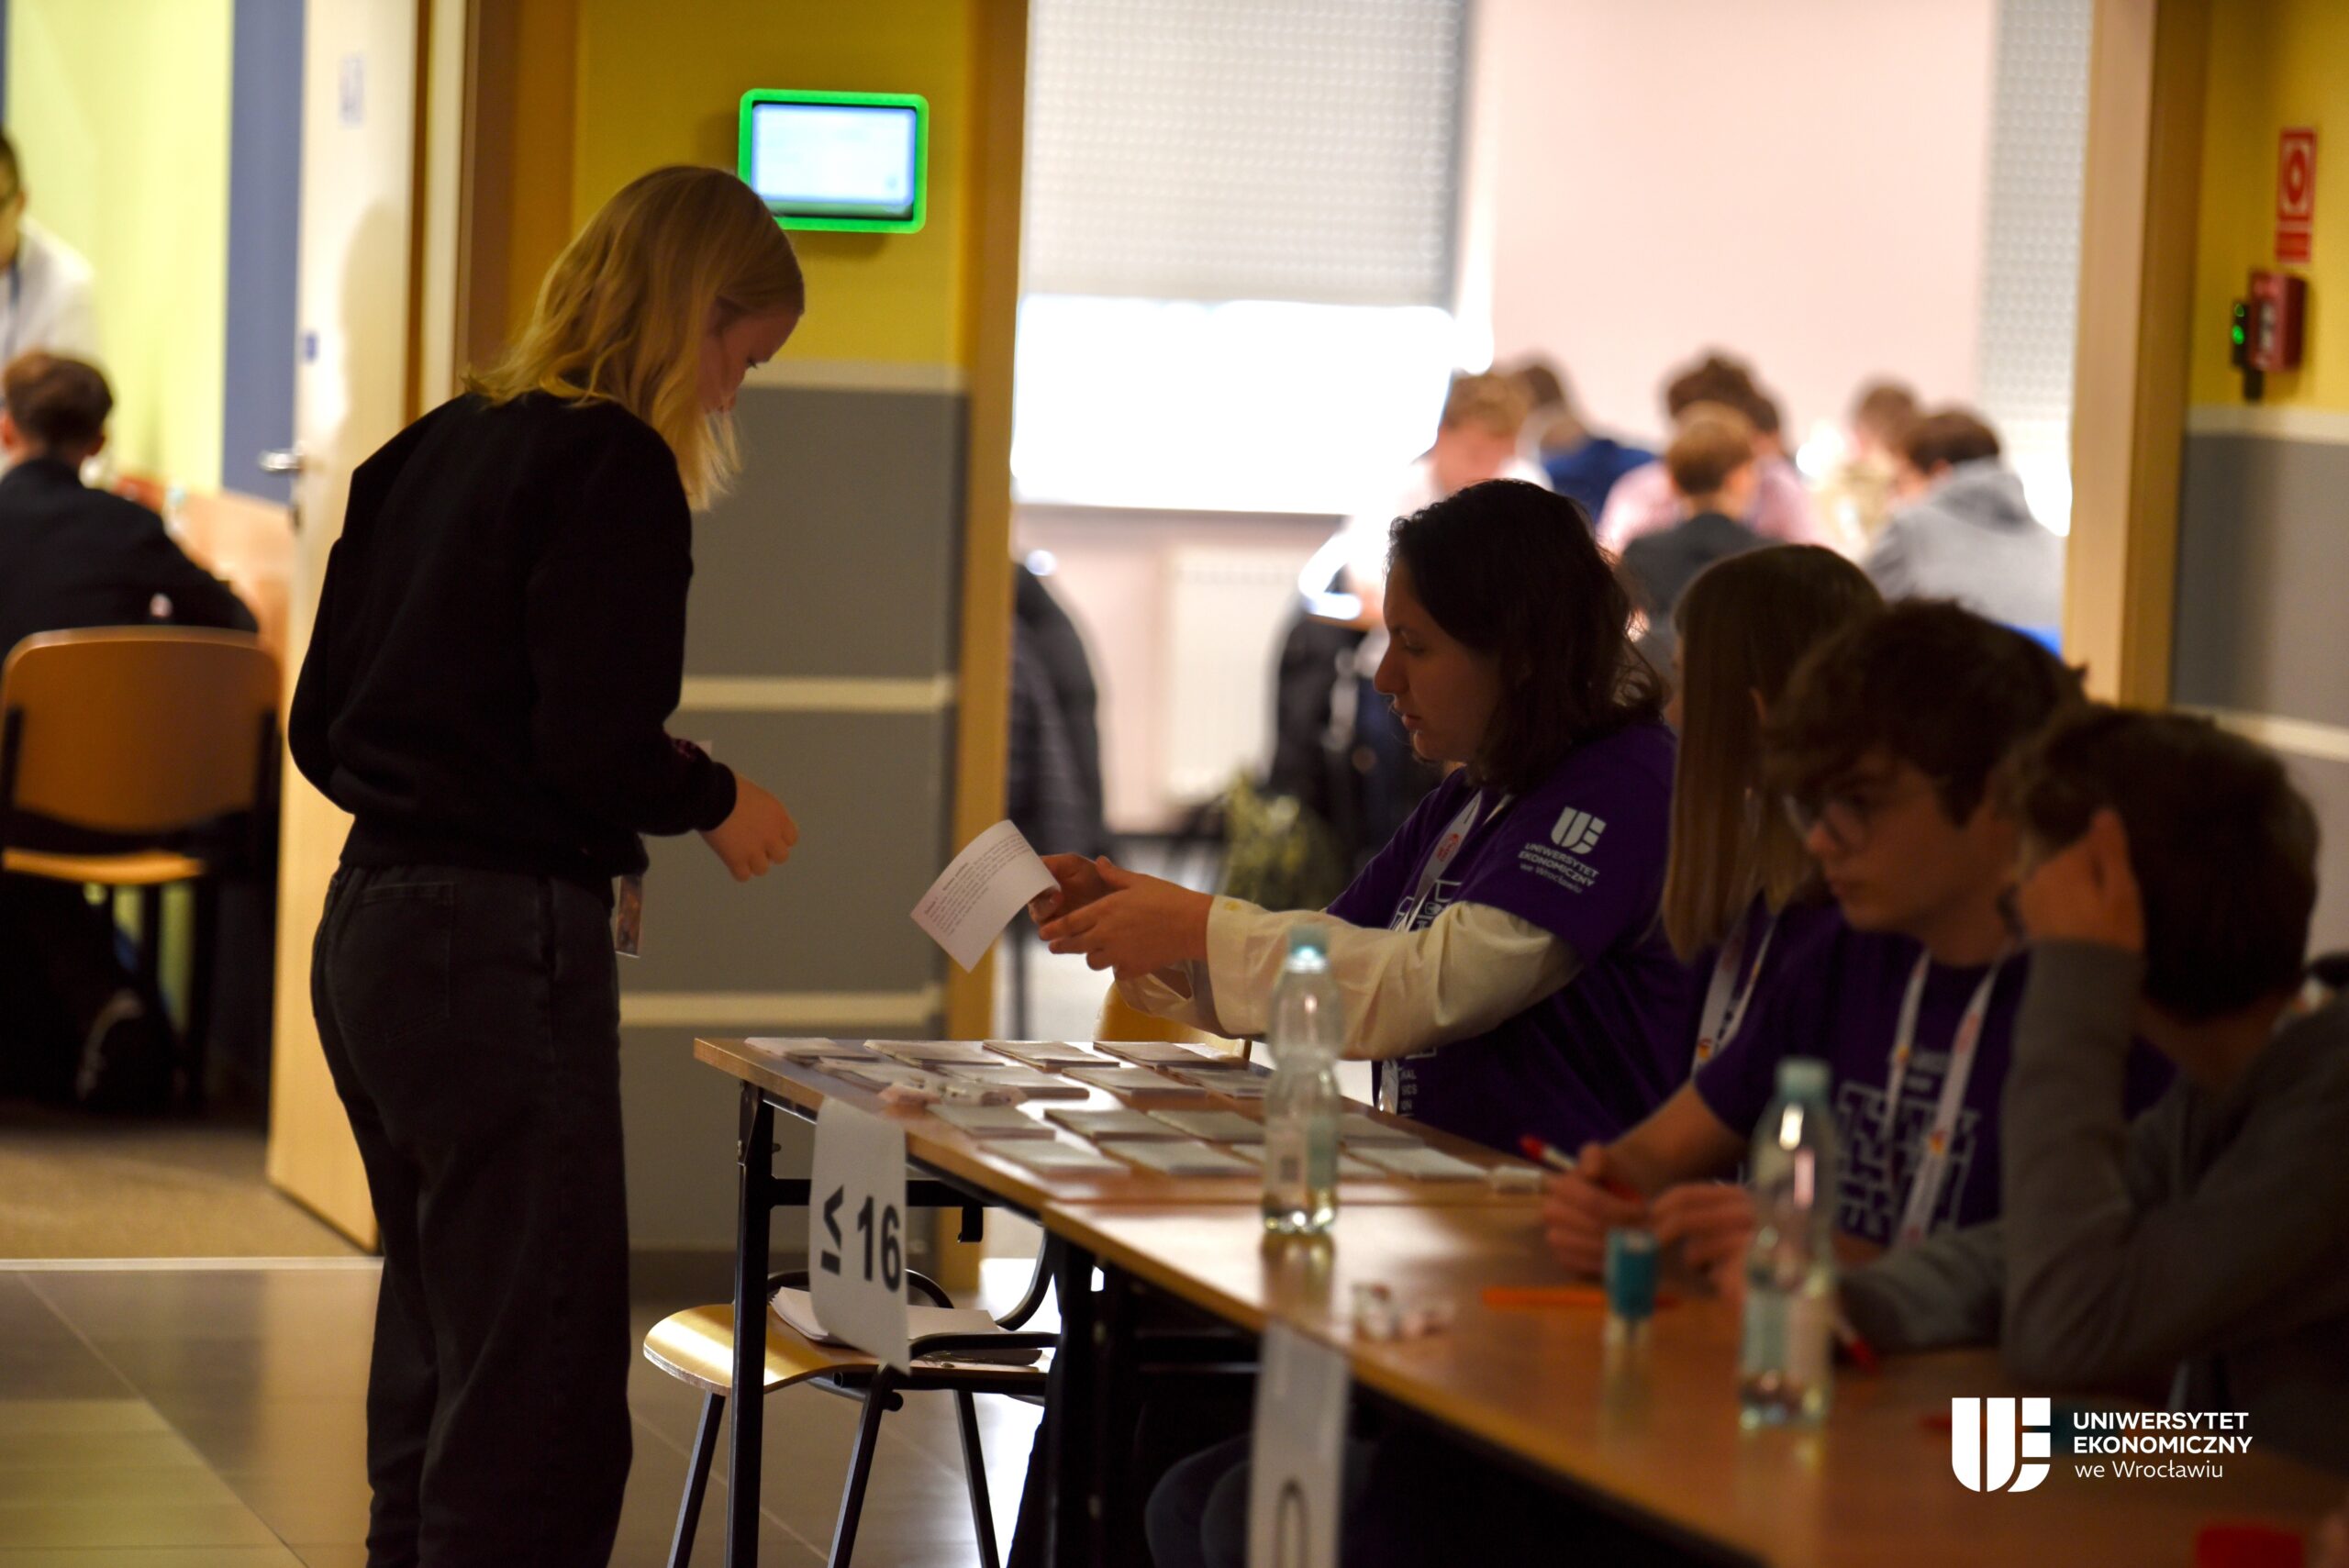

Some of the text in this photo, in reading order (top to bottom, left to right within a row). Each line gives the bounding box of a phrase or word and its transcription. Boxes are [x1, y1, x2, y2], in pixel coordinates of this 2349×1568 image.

[1518, 851, 1595, 887] EKONOMICZNY
[1524, 842, 1599, 877] UNIWERSYTET
[857, 1195, 901, 1293] 16
